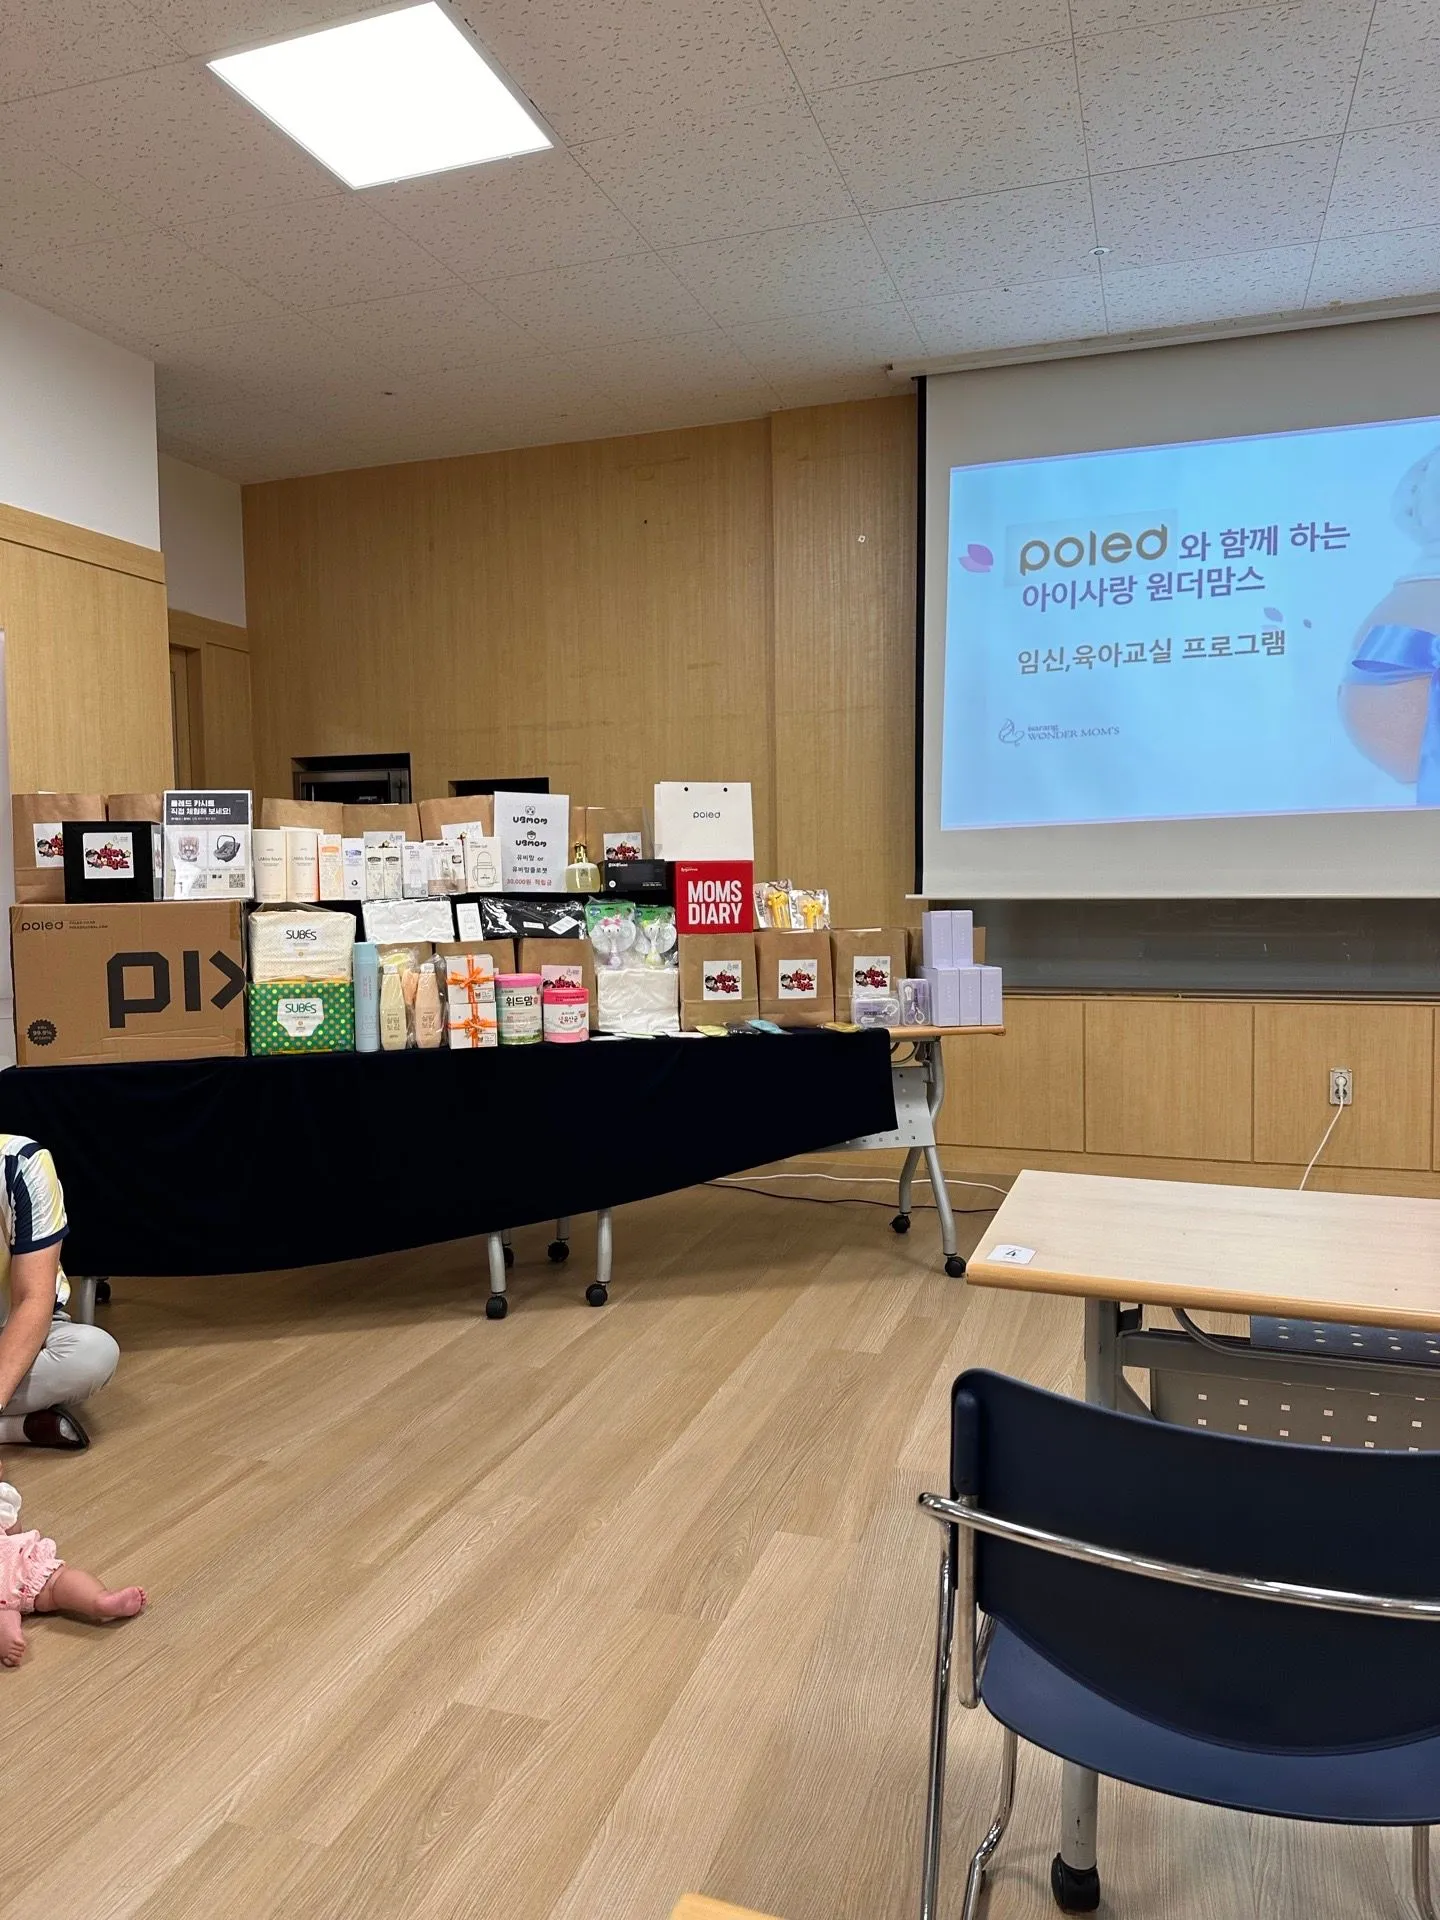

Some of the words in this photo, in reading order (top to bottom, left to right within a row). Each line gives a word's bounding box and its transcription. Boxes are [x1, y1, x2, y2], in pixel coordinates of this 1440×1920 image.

[1020, 524, 1168, 576] poled
[1179, 532, 1211, 561] 와
[1220, 525, 1279, 559] 함께
[1289, 522, 1350, 552] 하는
[1022, 575, 1138, 612] 아이사랑
[1146, 566, 1265, 601] 원더맘스
[1018, 638, 1172, 674] 임신,육아교실
[1182, 630, 1286, 658] 프로그램
[1028, 730, 1078, 740] WONDER
[693, 811, 721, 819] poled
[687, 880, 742, 903] MOMS
[688, 903, 743, 925] DIARY
[21, 920, 64, 932] poled
[506, 996, 533, 1007] 위드맘
